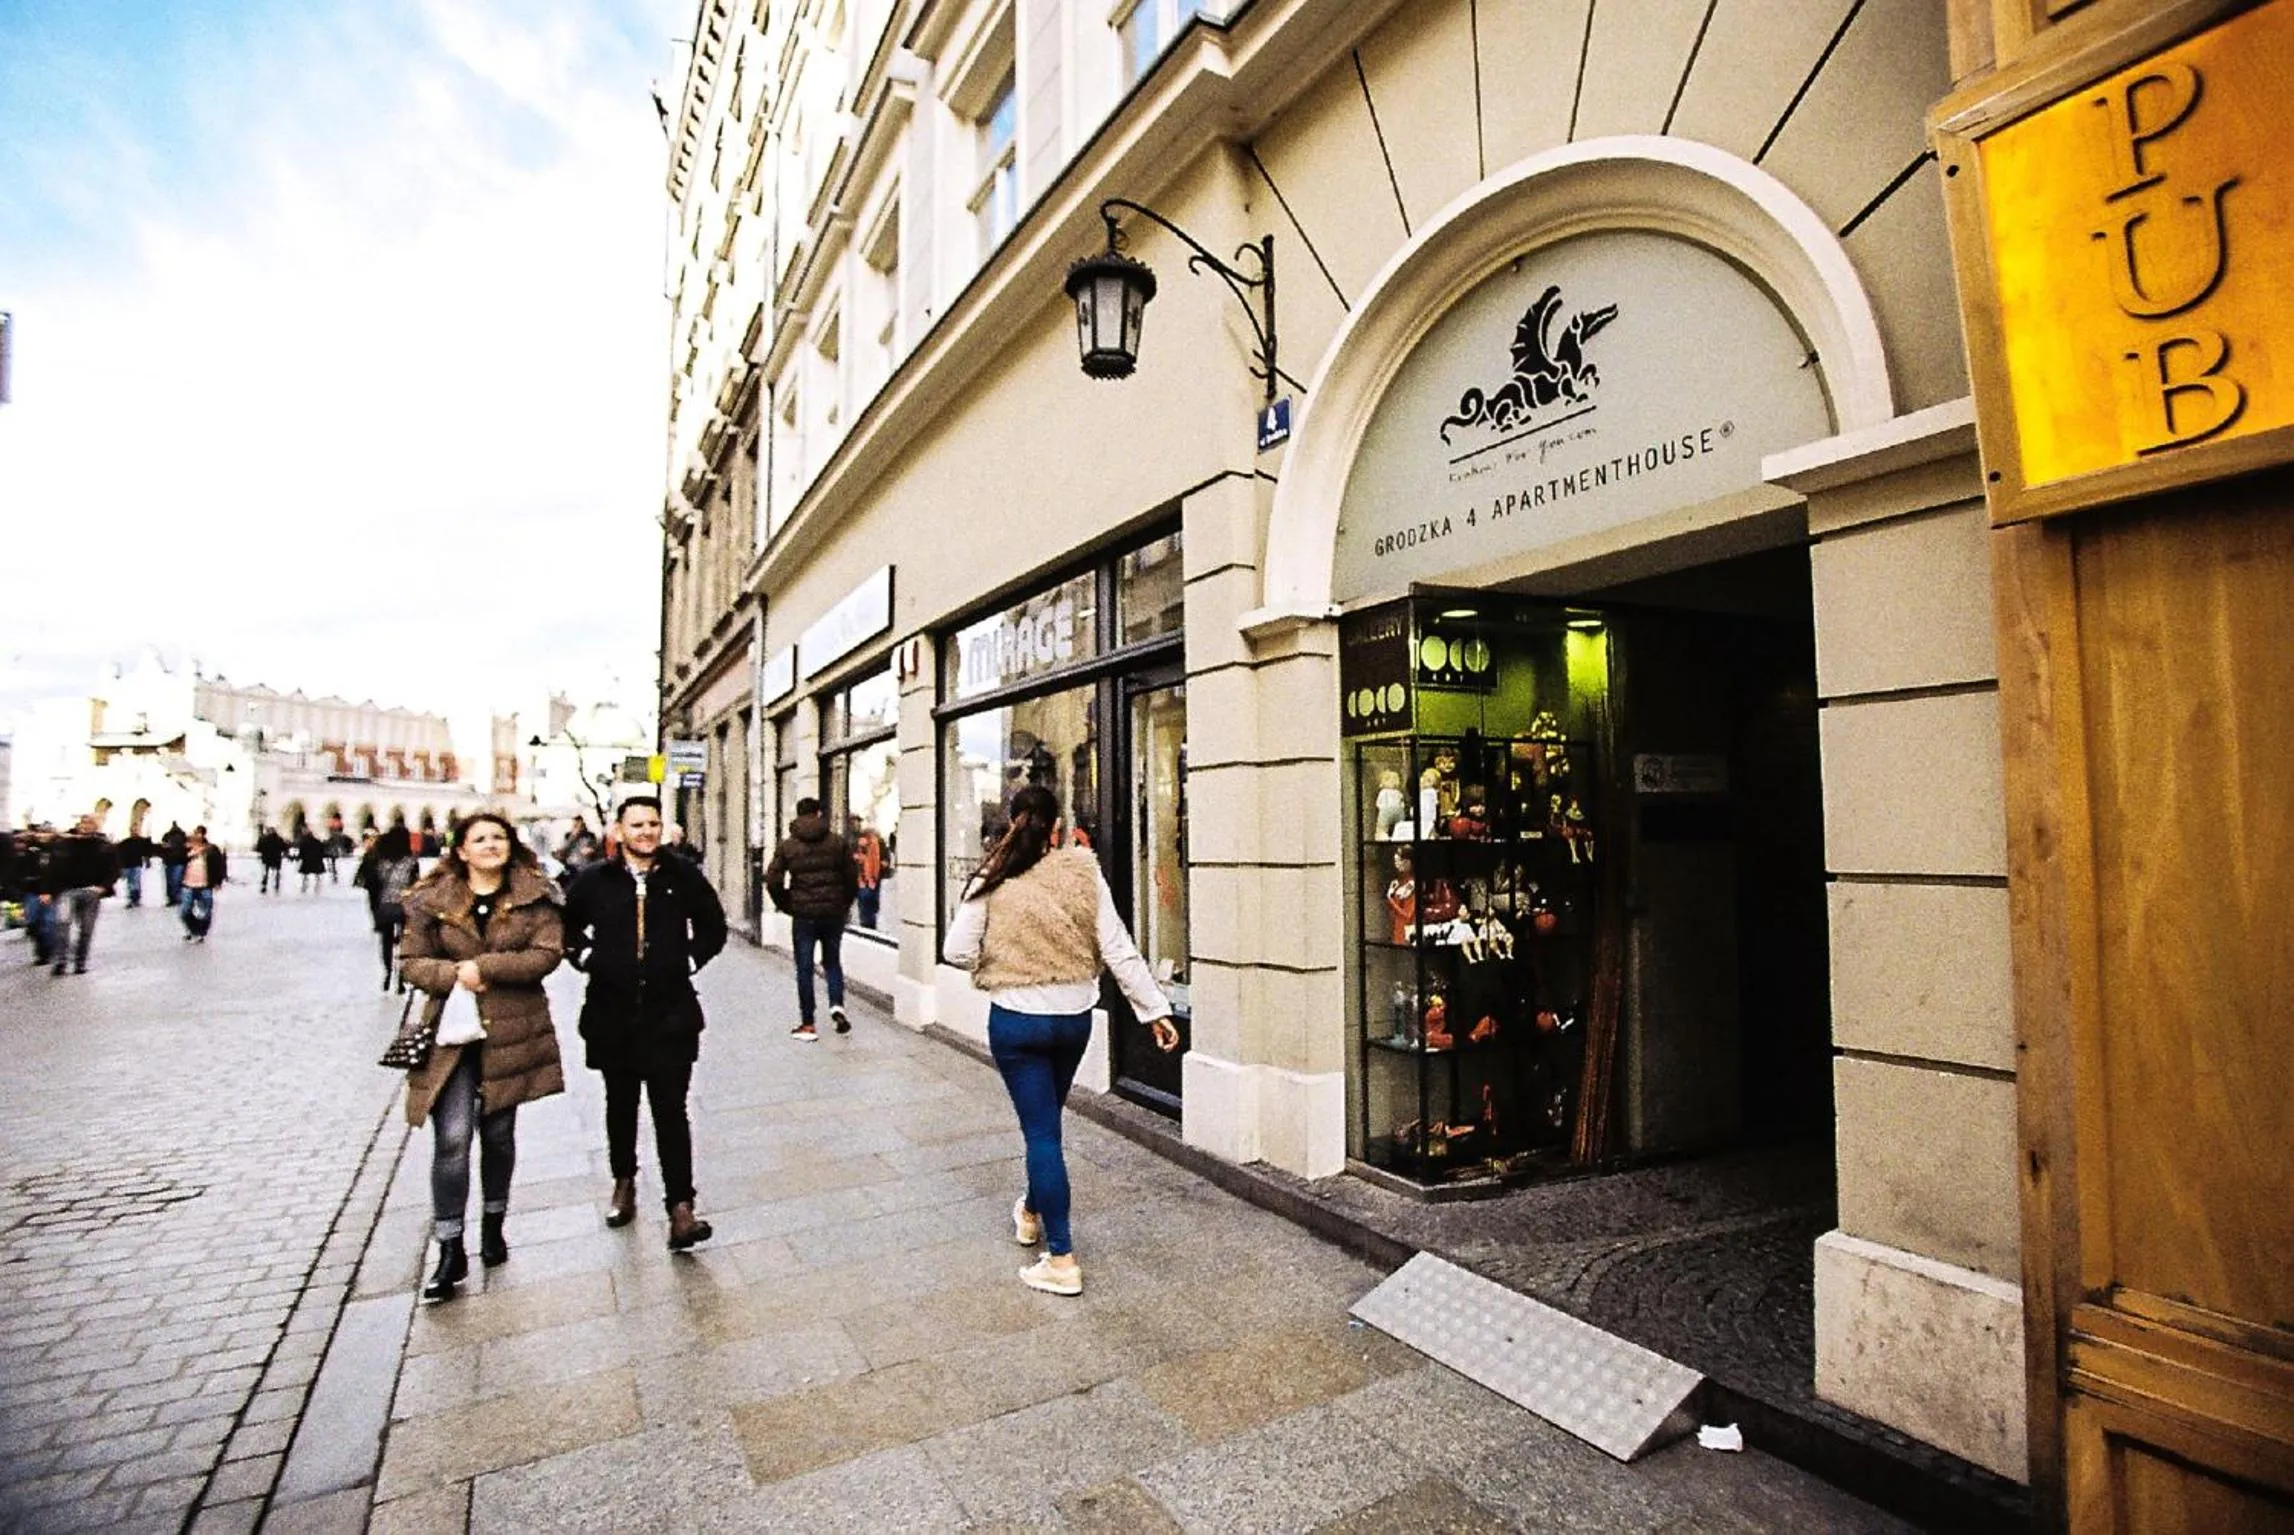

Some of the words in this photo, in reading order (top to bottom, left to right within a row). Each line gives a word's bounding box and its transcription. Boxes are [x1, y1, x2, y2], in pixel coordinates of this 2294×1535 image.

[2092, 60, 2248, 458] PUB
[1266, 406, 1278, 430] 4
[1374, 515, 1453, 556] GRODZKA
[1466, 507, 1476, 527] 4
[1492, 428, 1714, 520] APARTMENTHOUSE
